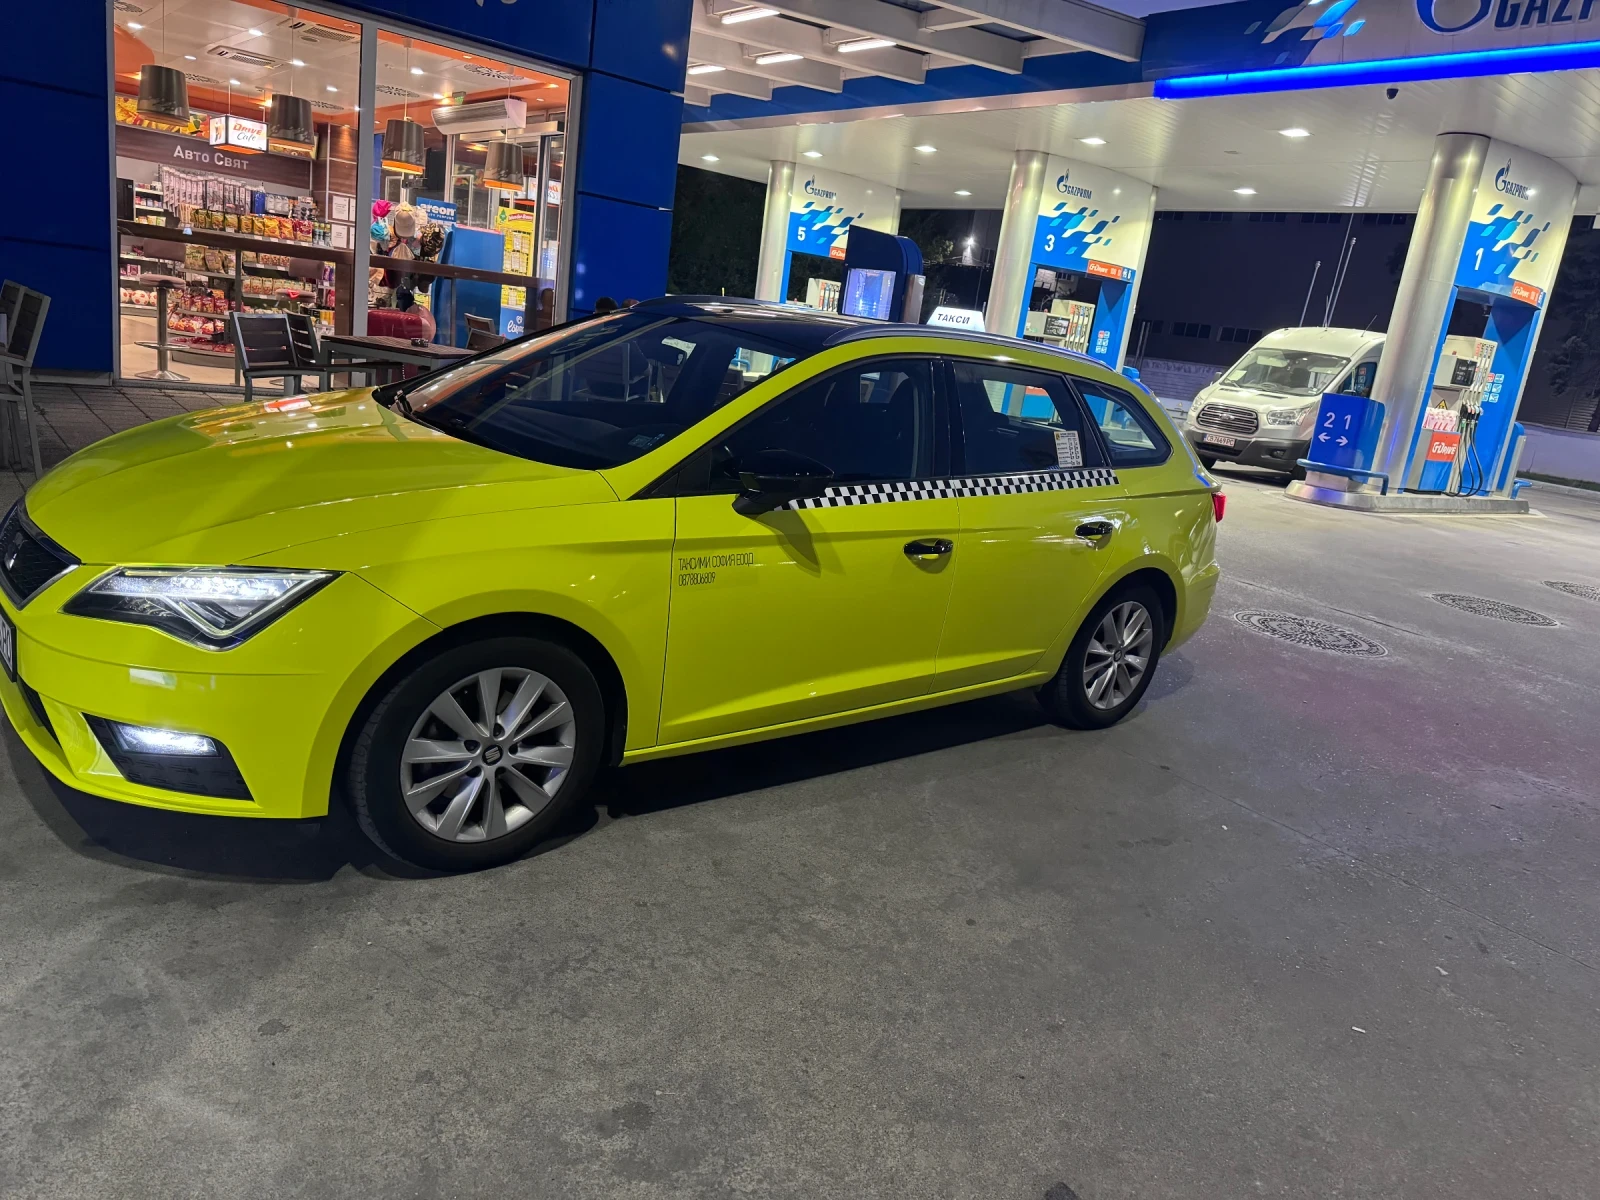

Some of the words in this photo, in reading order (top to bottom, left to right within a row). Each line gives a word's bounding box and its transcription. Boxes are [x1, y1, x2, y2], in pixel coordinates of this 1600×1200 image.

[173, 145, 210, 163] Авто
[214, 152, 249, 170] Свят
[797, 227, 807, 241] 5
[1044, 234, 1055, 252] 3
[1474, 248, 1485, 271] 1
[937, 313, 971, 325] ТАКСИ
[1323, 412, 1336, 429] 2
[1344, 414, 1352, 431] 1
[678, 555, 711, 571] ТАКСИМИ
[711, 553, 736, 568] СОФИЯ
[736, 552, 754, 567] ЕООД
[678, 572, 716, 587] 0878806809
